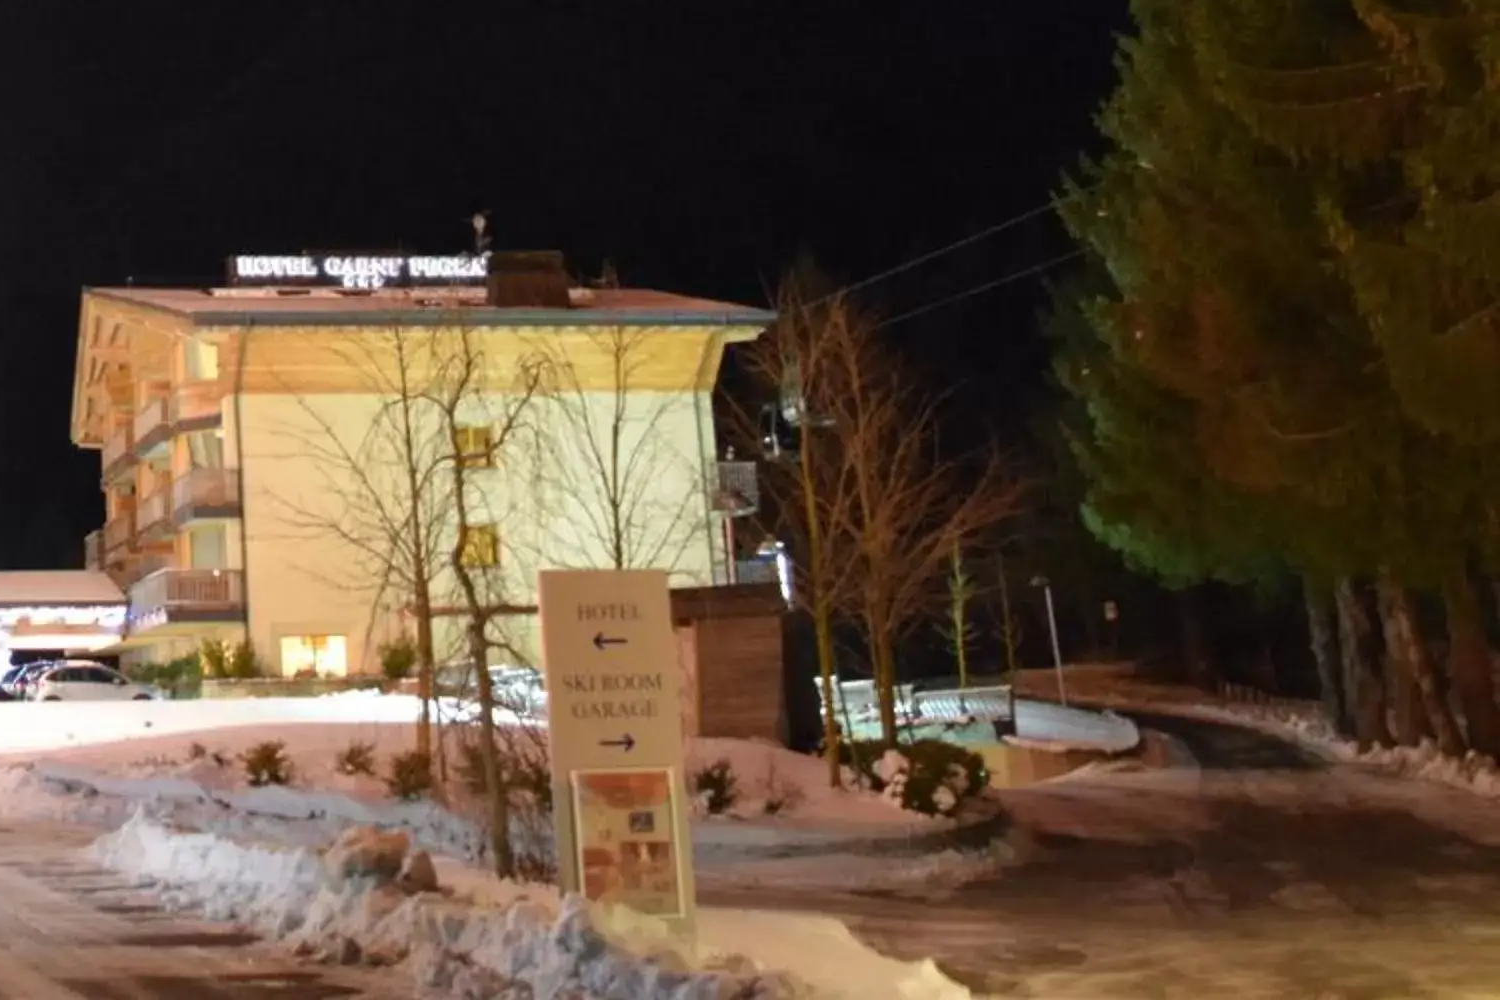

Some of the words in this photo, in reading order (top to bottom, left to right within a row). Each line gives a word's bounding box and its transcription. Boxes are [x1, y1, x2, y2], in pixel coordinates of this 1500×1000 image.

[237, 256, 317, 277] HOTEL
[576, 602, 643, 622] HOTEL
[562, 673, 596, 693] SKI
[600, 672, 663, 692] ROOM
[571, 699, 659, 720] GARAGE
